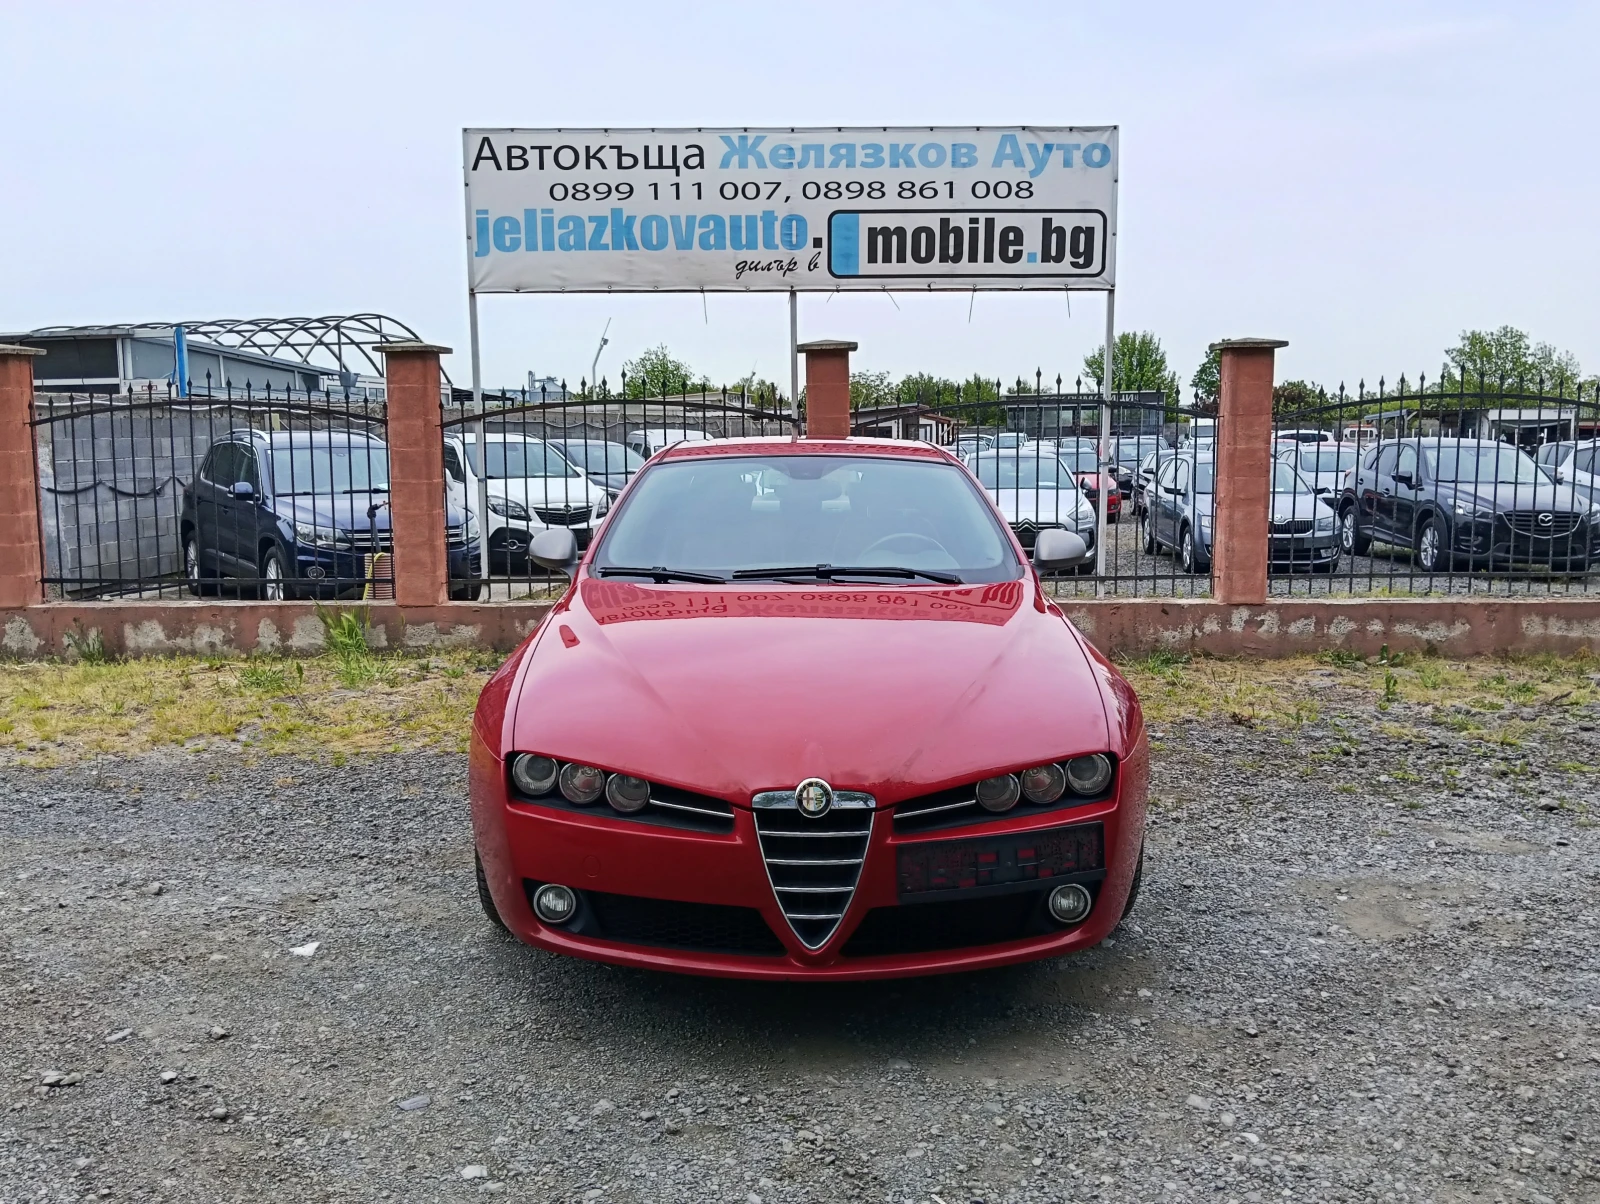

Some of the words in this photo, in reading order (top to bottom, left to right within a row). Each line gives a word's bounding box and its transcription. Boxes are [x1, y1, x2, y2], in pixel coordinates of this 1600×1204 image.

[471, 136, 705, 177] Автокъща
[718, 134, 979, 170] Желязков
[991, 133, 1112, 179] Ауто
[549, 181, 634, 201] 0899
[648, 181, 703, 200] 111
[719, 181, 791, 203] 007,
[801, 180, 886, 200] 0898
[897, 180, 954, 200] 861
[970, 180, 1034, 199] 008
[867, 217, 1096, 269] mobile.bg
[735, 257, 799, 279] дилър
